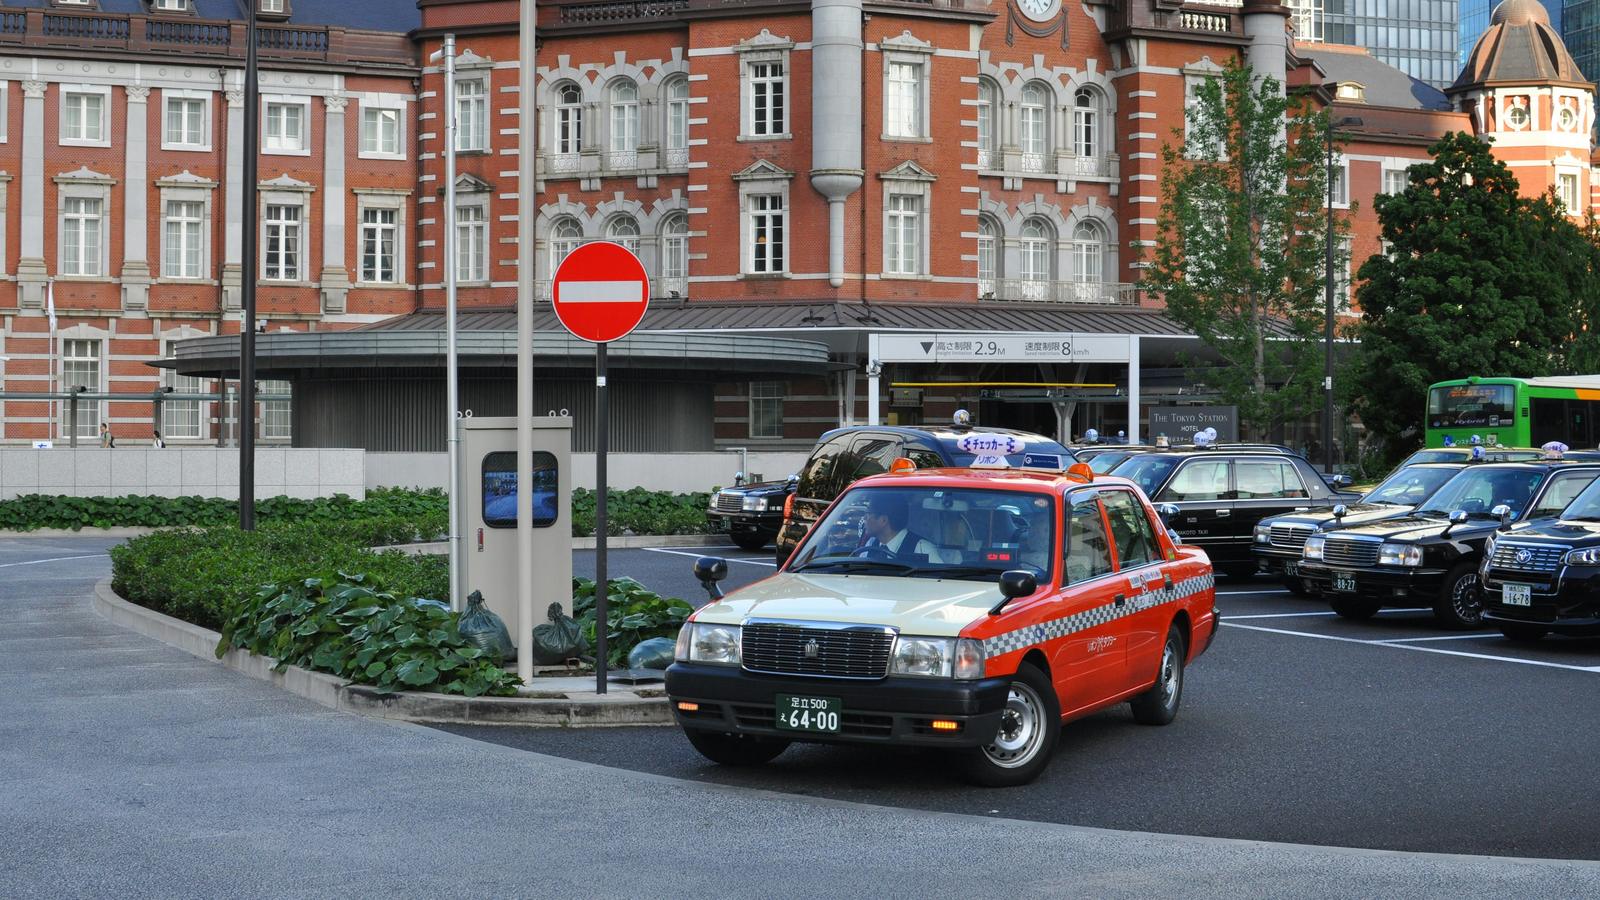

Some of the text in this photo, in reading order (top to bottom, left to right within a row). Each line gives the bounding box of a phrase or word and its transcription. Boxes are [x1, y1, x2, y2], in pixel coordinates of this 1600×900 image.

[937, 341, 972, 351] 高さ制限
[1024, 341, 1060, 351] 速度制限
[972, 439, 1003, 450] チェッカー
[978, 455, 999, 465] リボン
[1337, 579, 1355, 590] 88-27
[1509, 592, 1530, 605] 16-78
[791, 697, 828, 710] 足立 500
[789, 709, 838, 731] 64-00
